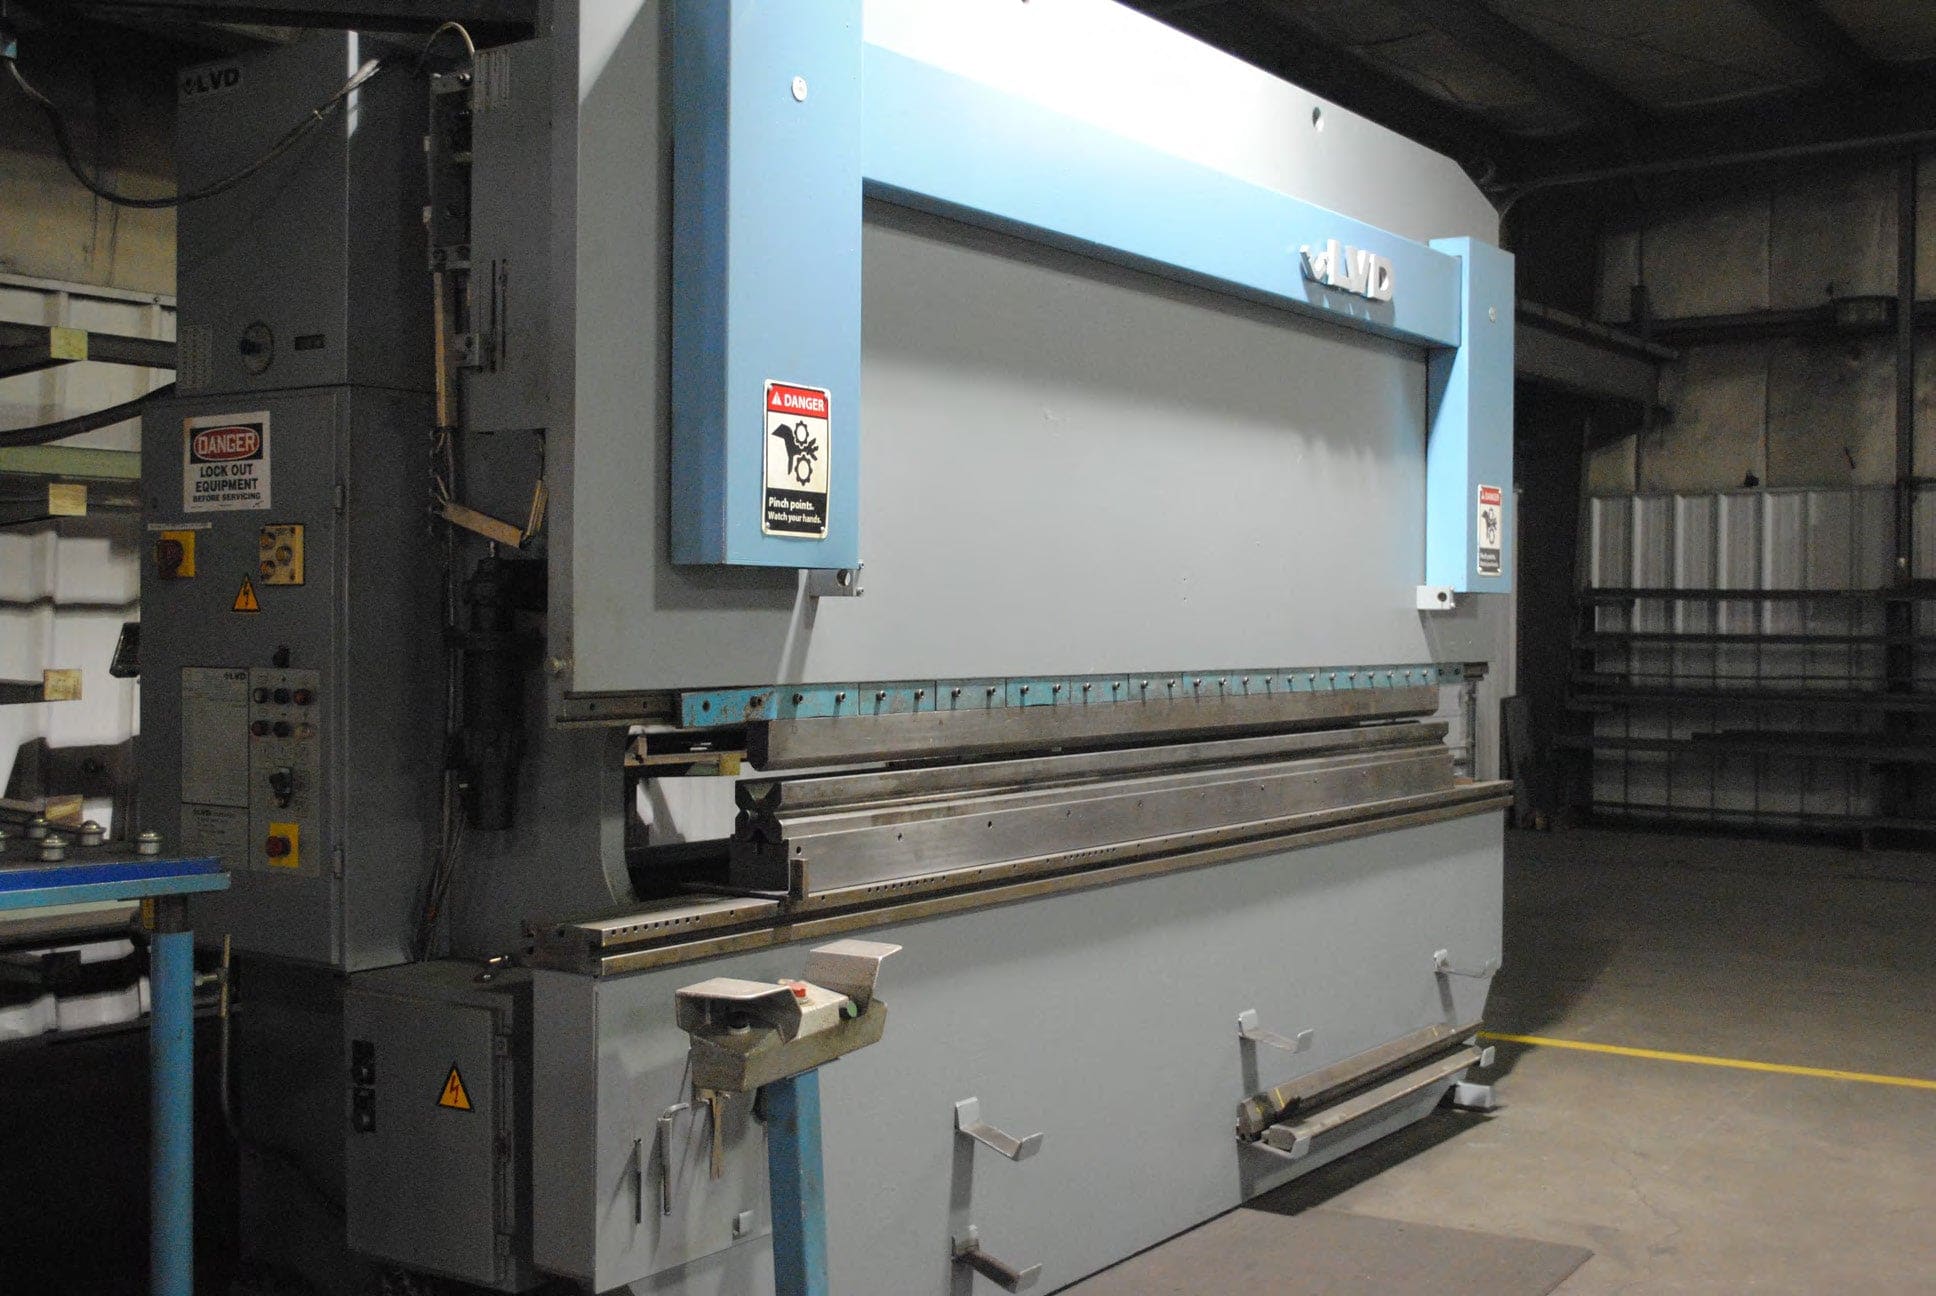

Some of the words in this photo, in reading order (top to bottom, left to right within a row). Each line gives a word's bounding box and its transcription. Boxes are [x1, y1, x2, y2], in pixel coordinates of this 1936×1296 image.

[784, 394, 825, 412] DANGER
[198, 433, 255, 454] DANGER
[200, 464, 228, 478] LOCK
[231, 463, 253, 476] OUT
[195, 478, 258, 493] EQUIPMENT
[193, 494, 220, 503] BEFORE
[222, 492, 261, 501] SERVICING
[768, 496, 789, 509] Pinch
[767, 511, 788, 521] Watch
[788, 514, 802, 523] your
